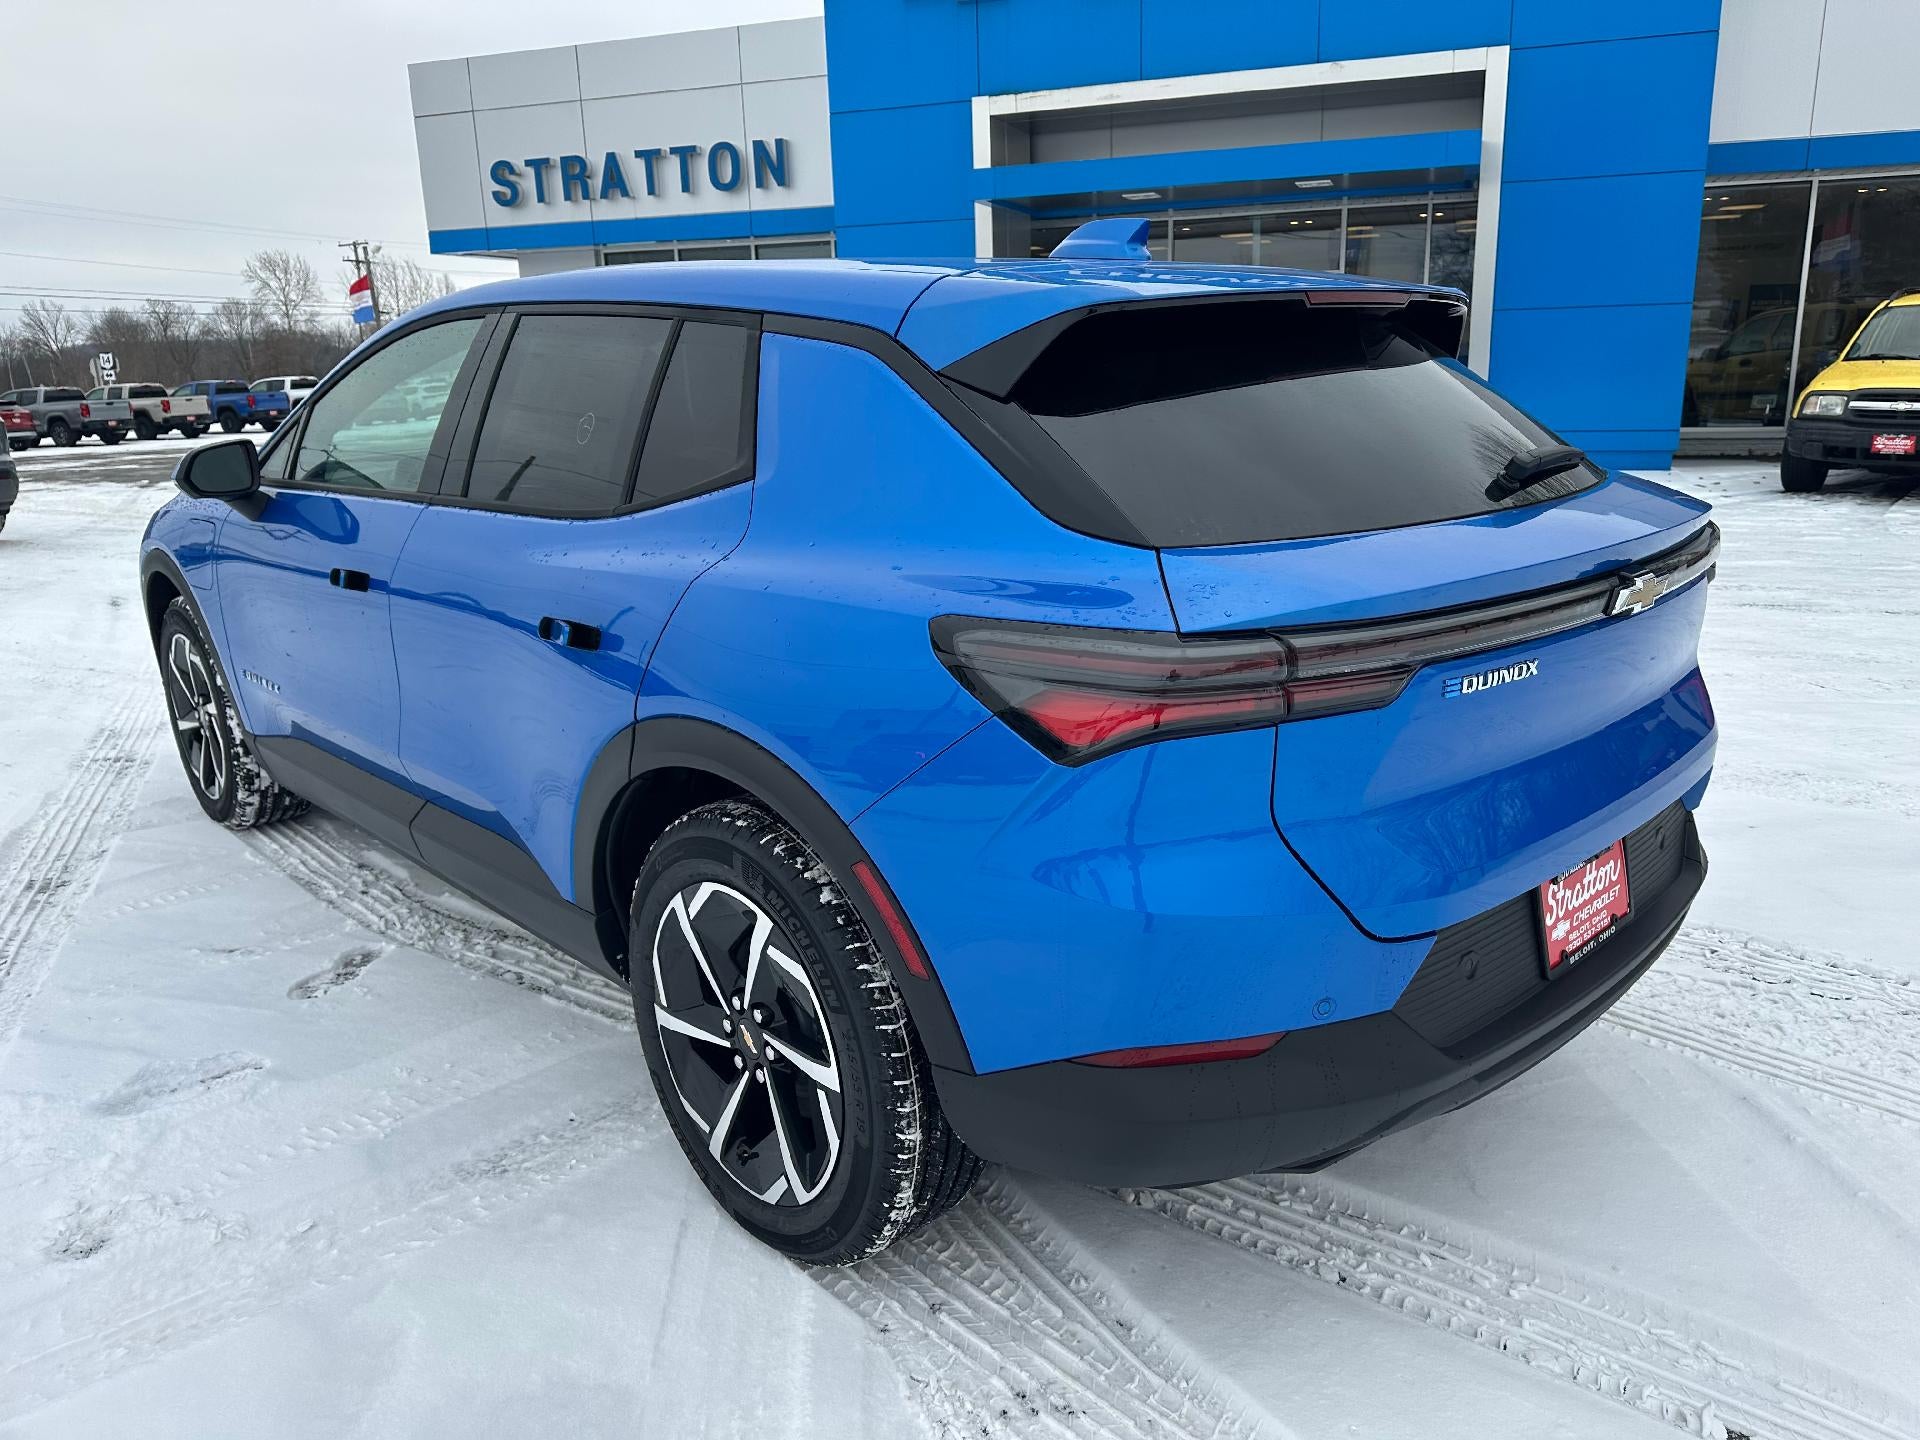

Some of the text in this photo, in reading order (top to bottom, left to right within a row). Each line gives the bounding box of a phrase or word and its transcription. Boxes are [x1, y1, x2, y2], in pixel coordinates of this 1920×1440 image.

[490, 138, 790, 207] STRATTON
[1443, 658, 1539, 698] EQUINOX
[1546, 859, 1621, 926] Stratton
[1572, 884, 1621, 927] CHEVROLET
[1592, 910, 1608, 926] OHIO
[765, 889, 842, 1007] MICHELIN
[1569, 926, 1616, 965] BELOIT, OHIO
